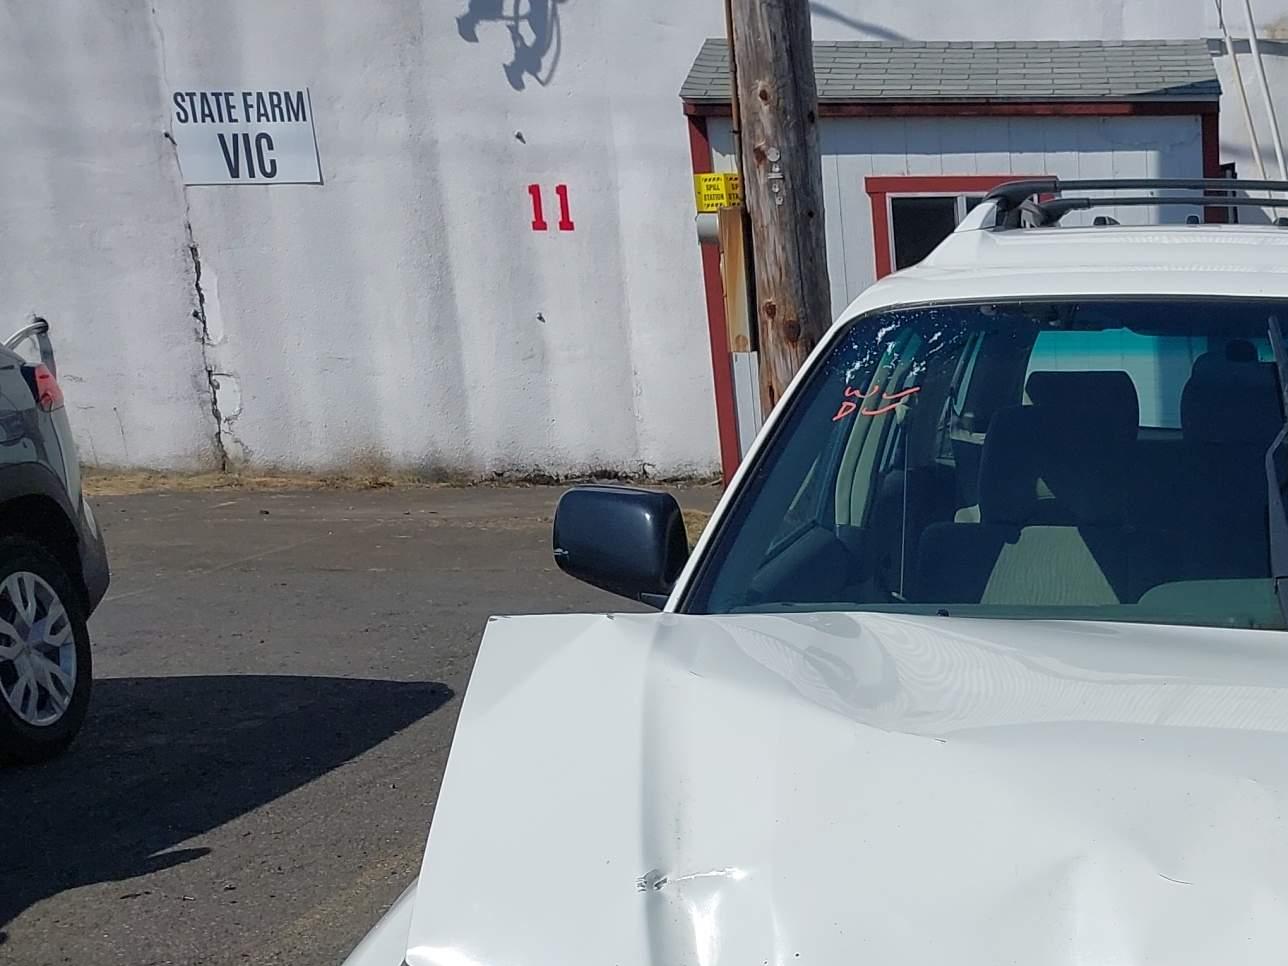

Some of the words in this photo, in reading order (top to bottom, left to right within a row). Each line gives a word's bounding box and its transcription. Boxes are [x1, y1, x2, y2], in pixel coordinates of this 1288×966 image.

[173, 91, 239, 123] STATE
[242, 91, 307, 122] FARM
[217, 132, 277, 178] VIC
[528, 184, 574, 230] 11
